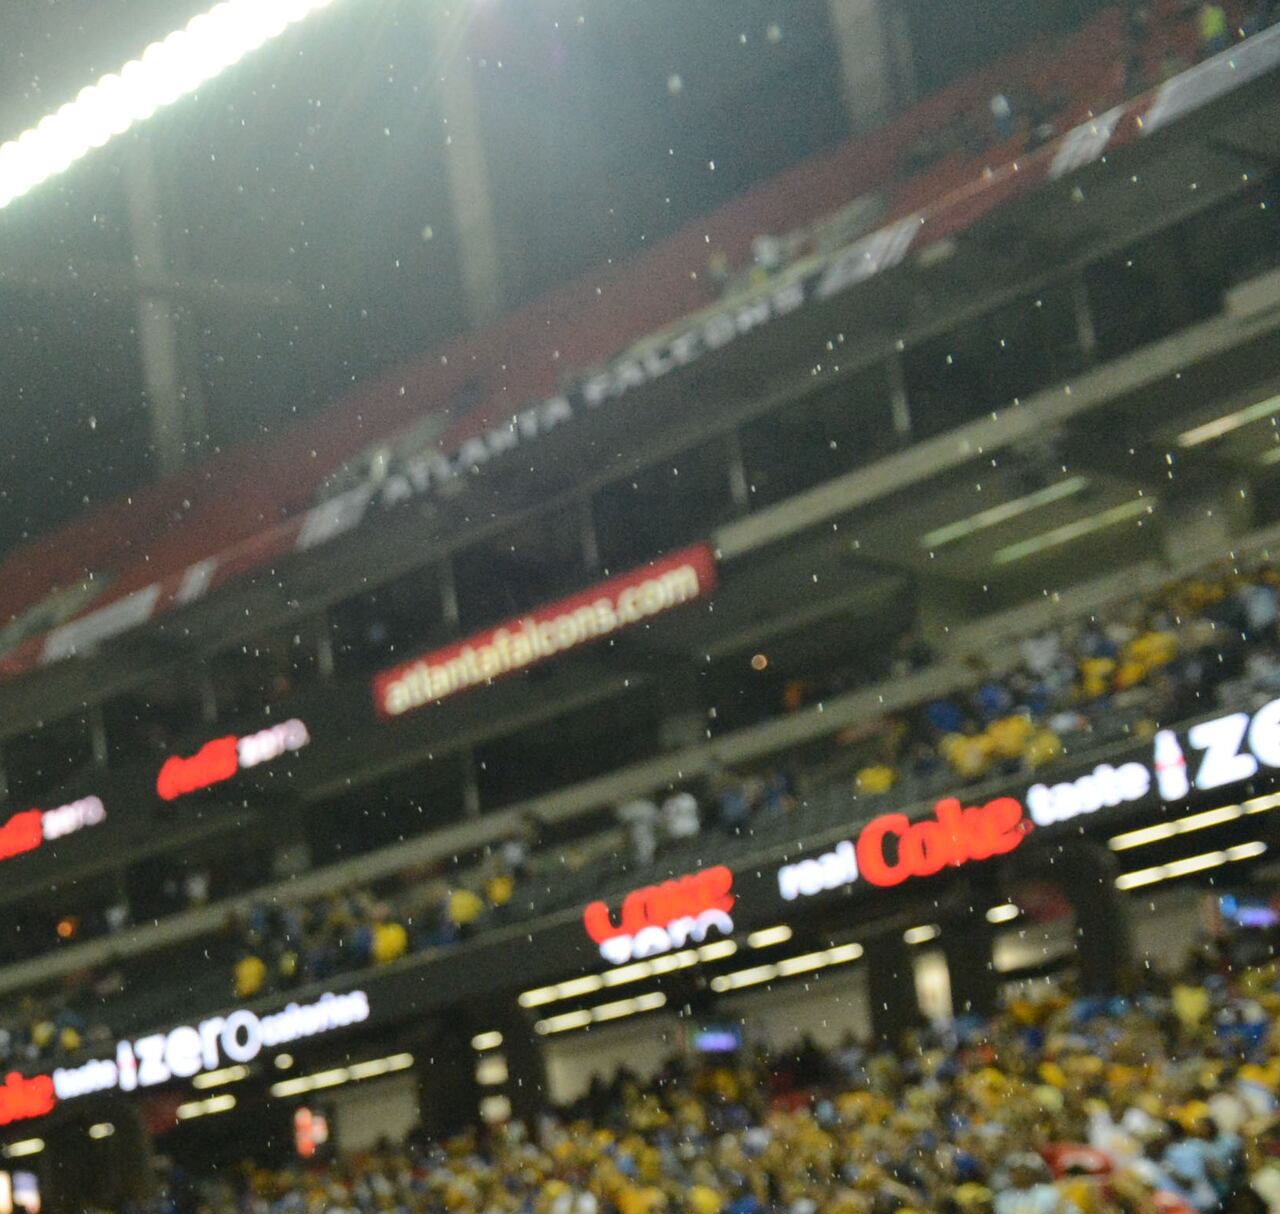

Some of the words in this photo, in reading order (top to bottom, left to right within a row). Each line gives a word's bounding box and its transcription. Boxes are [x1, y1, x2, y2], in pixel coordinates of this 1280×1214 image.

[385, 564, 699, 716] atlantafalcons.com
[857, 796, 1027, 887] Coke
[134, 1009, 262, 1087] zero
